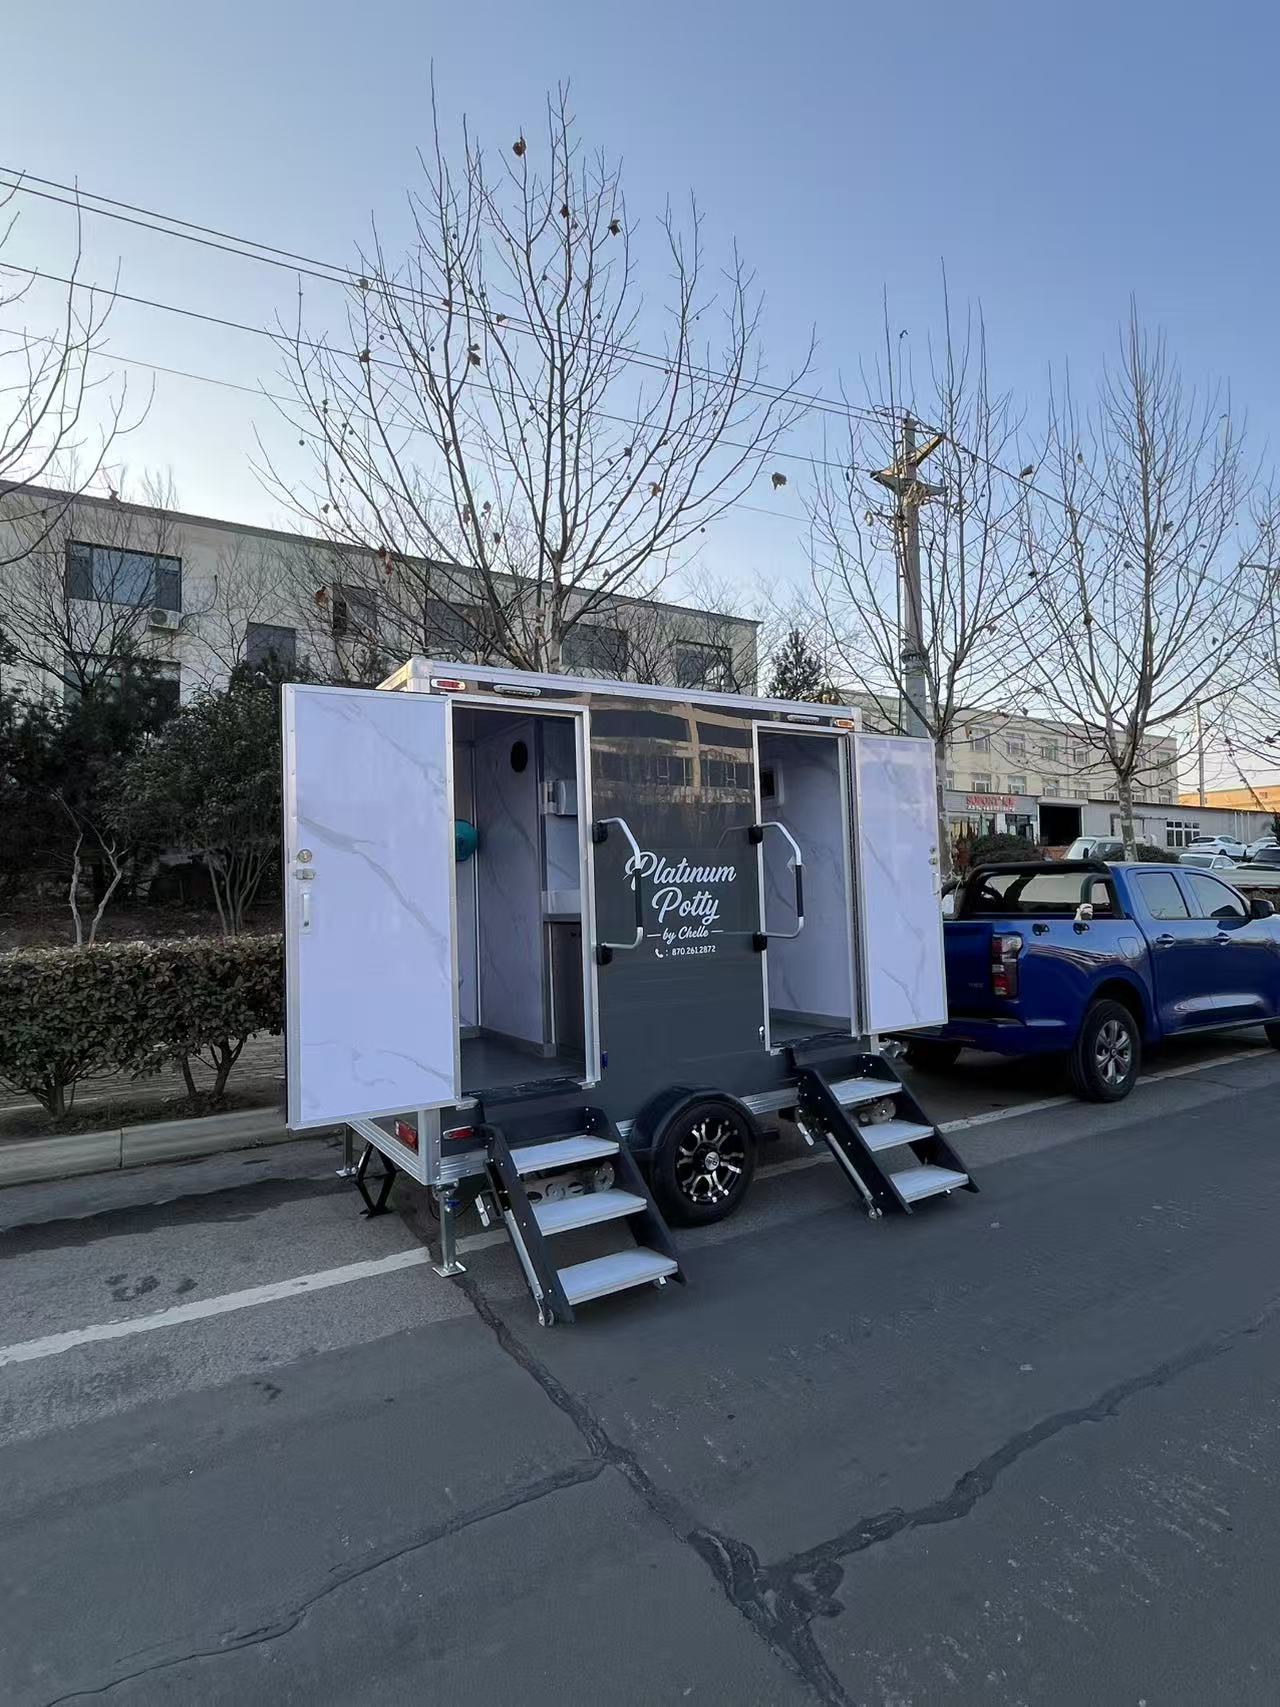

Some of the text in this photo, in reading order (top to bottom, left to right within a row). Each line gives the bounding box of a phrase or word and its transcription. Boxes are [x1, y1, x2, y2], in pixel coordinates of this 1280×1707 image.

[623, 851, 737, 891] Platinum
[652, 887, 720, 925] Potty
[662, 926, 709, 945] by Chelle
